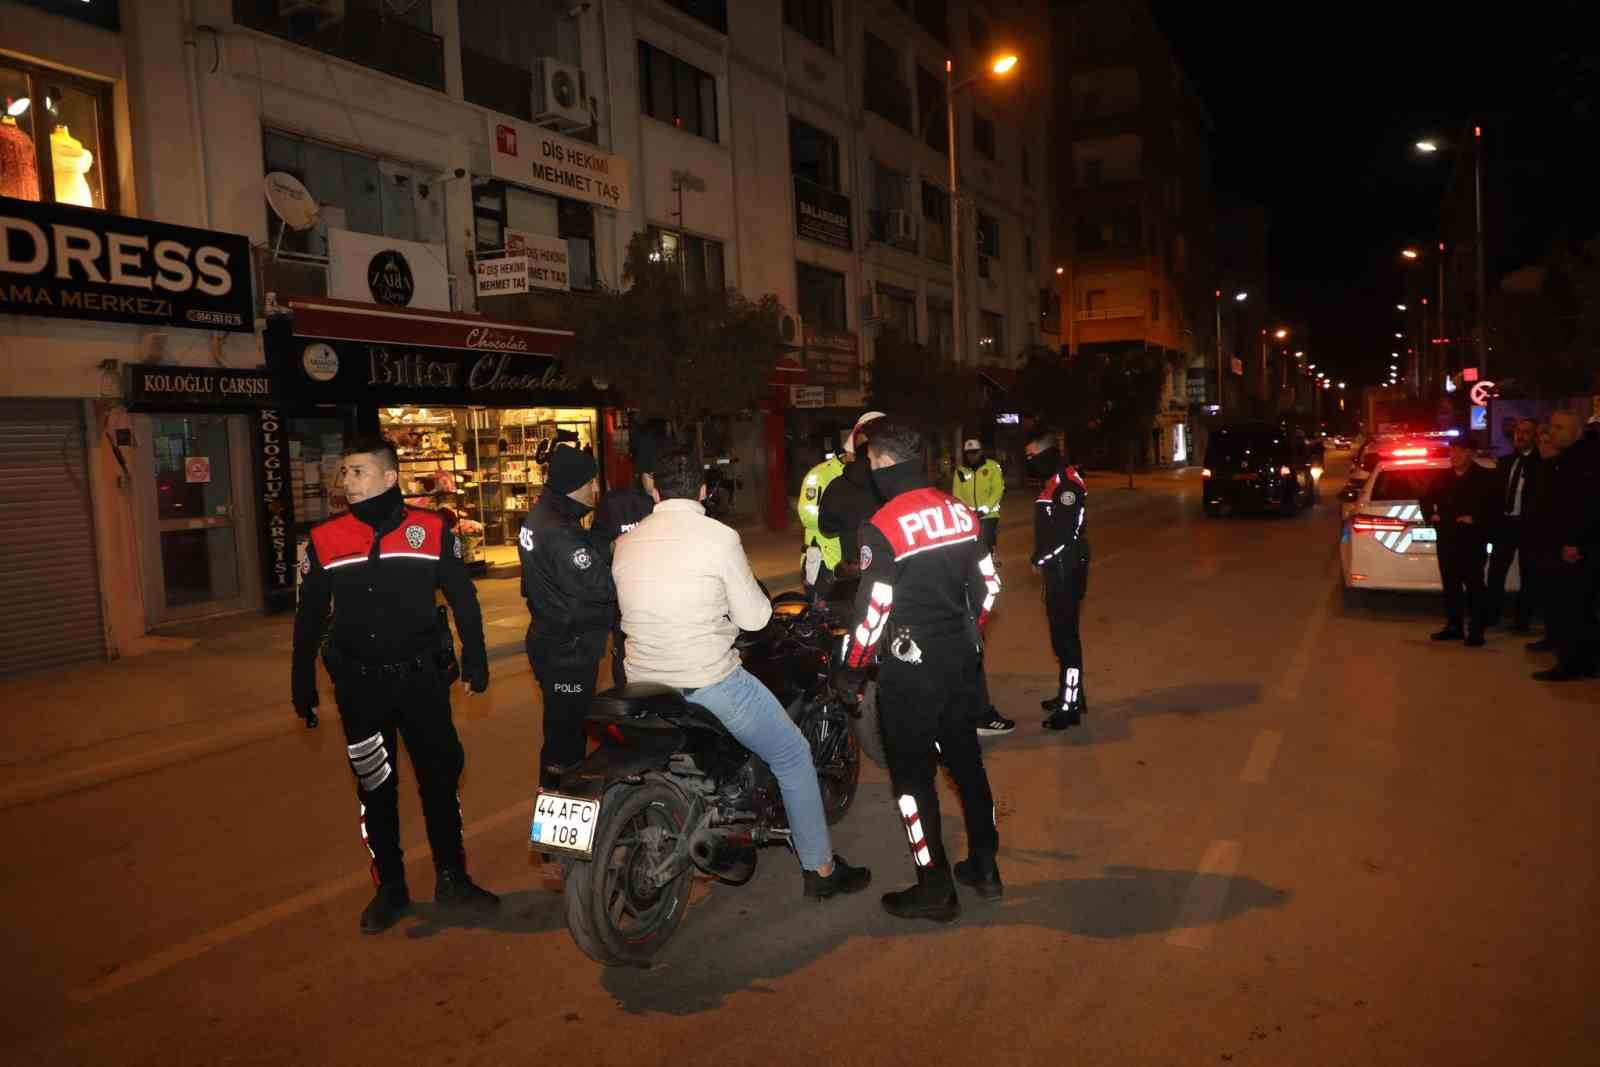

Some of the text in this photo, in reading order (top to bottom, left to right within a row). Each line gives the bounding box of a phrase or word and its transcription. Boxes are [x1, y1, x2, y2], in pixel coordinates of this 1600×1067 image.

[532, 161, 621, 203] MEHMET TAŞ
[0, 216, 233, 296] DRESS
[479, 277, 527, 291] MEHMET TAŞ
[465, 328, 529, 352] Chocolate
[143, 372, 214, 393] KOLOĞLU
[897, 499, 973, 546] POLİS
[538, 798, 592, 823] 44 AFC
[552, 824, 578, 845] 108
